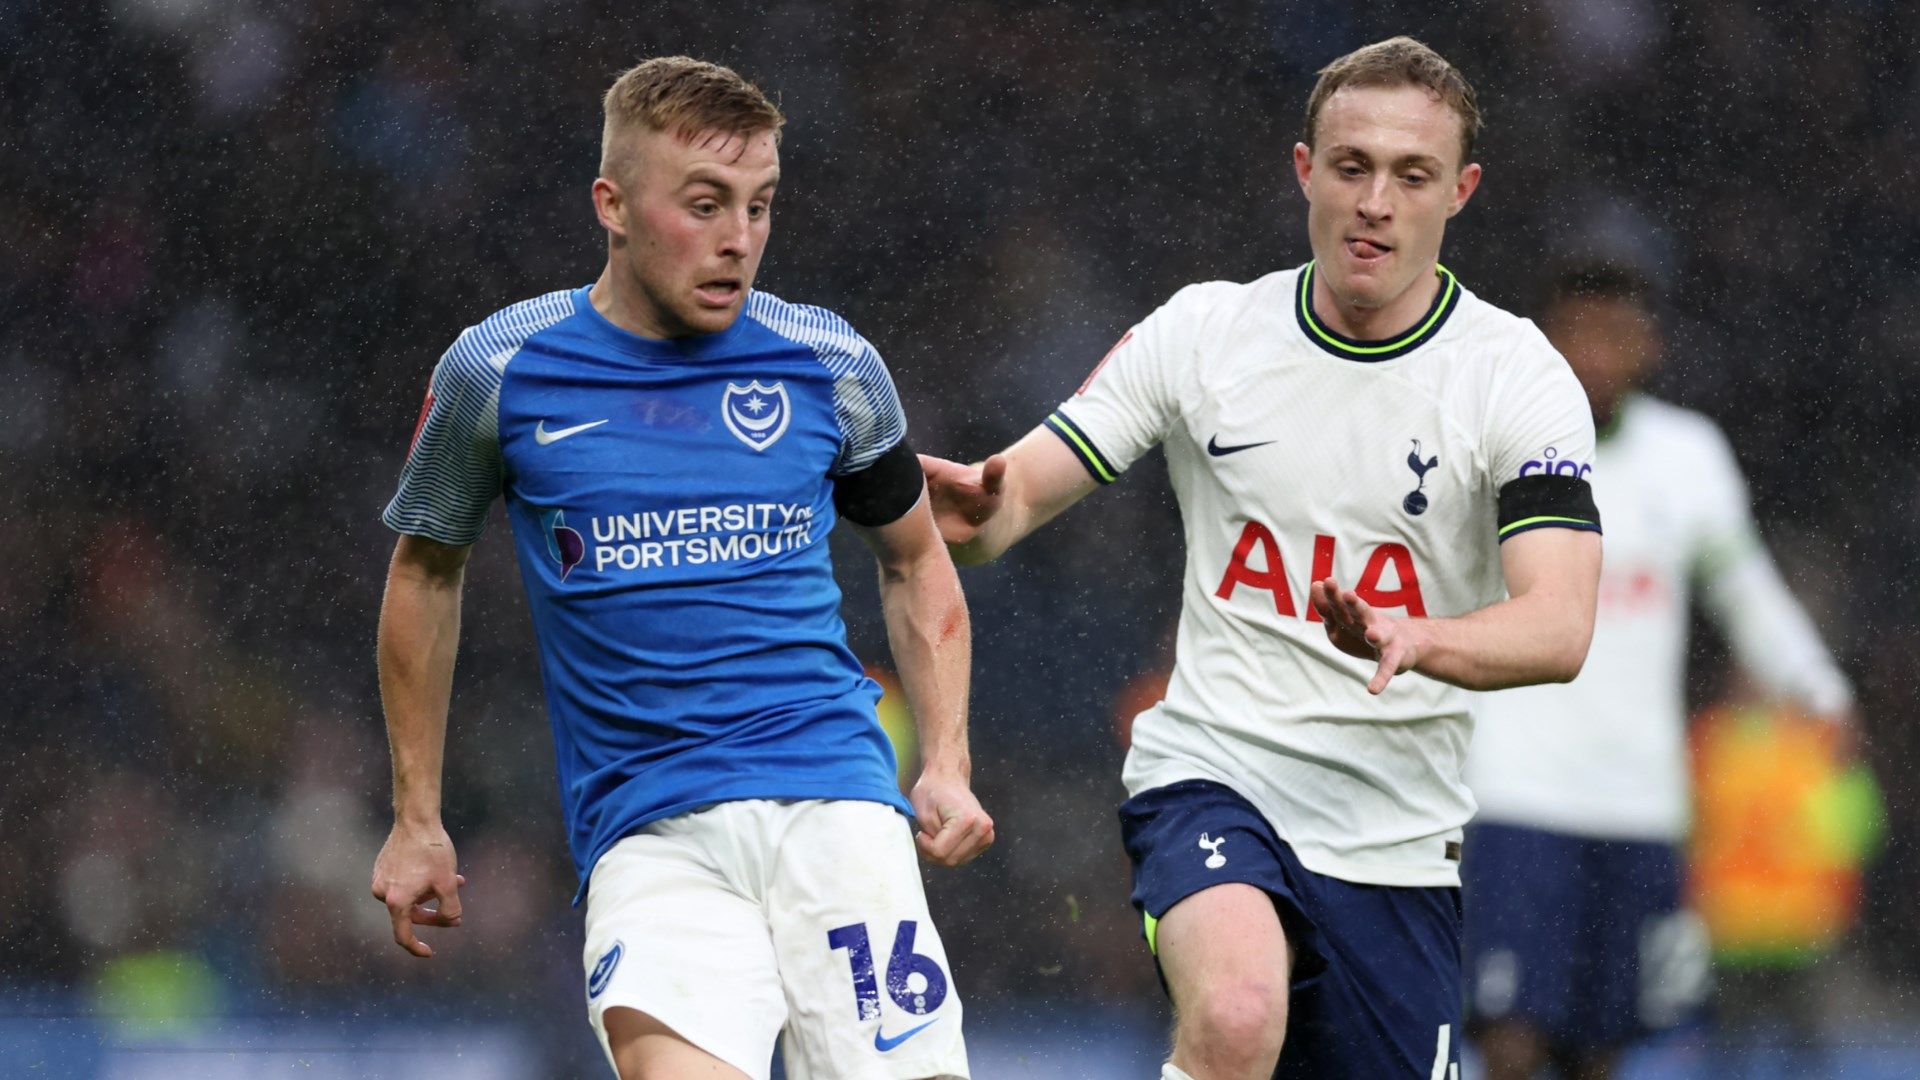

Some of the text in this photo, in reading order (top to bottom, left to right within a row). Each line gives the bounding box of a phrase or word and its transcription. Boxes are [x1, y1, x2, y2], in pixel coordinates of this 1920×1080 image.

[592, 503, 798, 542] UNIVERSITY
[595, 523, 812, 572] PORTSMOUTH
[1214, 519, 1428, 623] AIA
[827, 920, 948, 1021] 16
